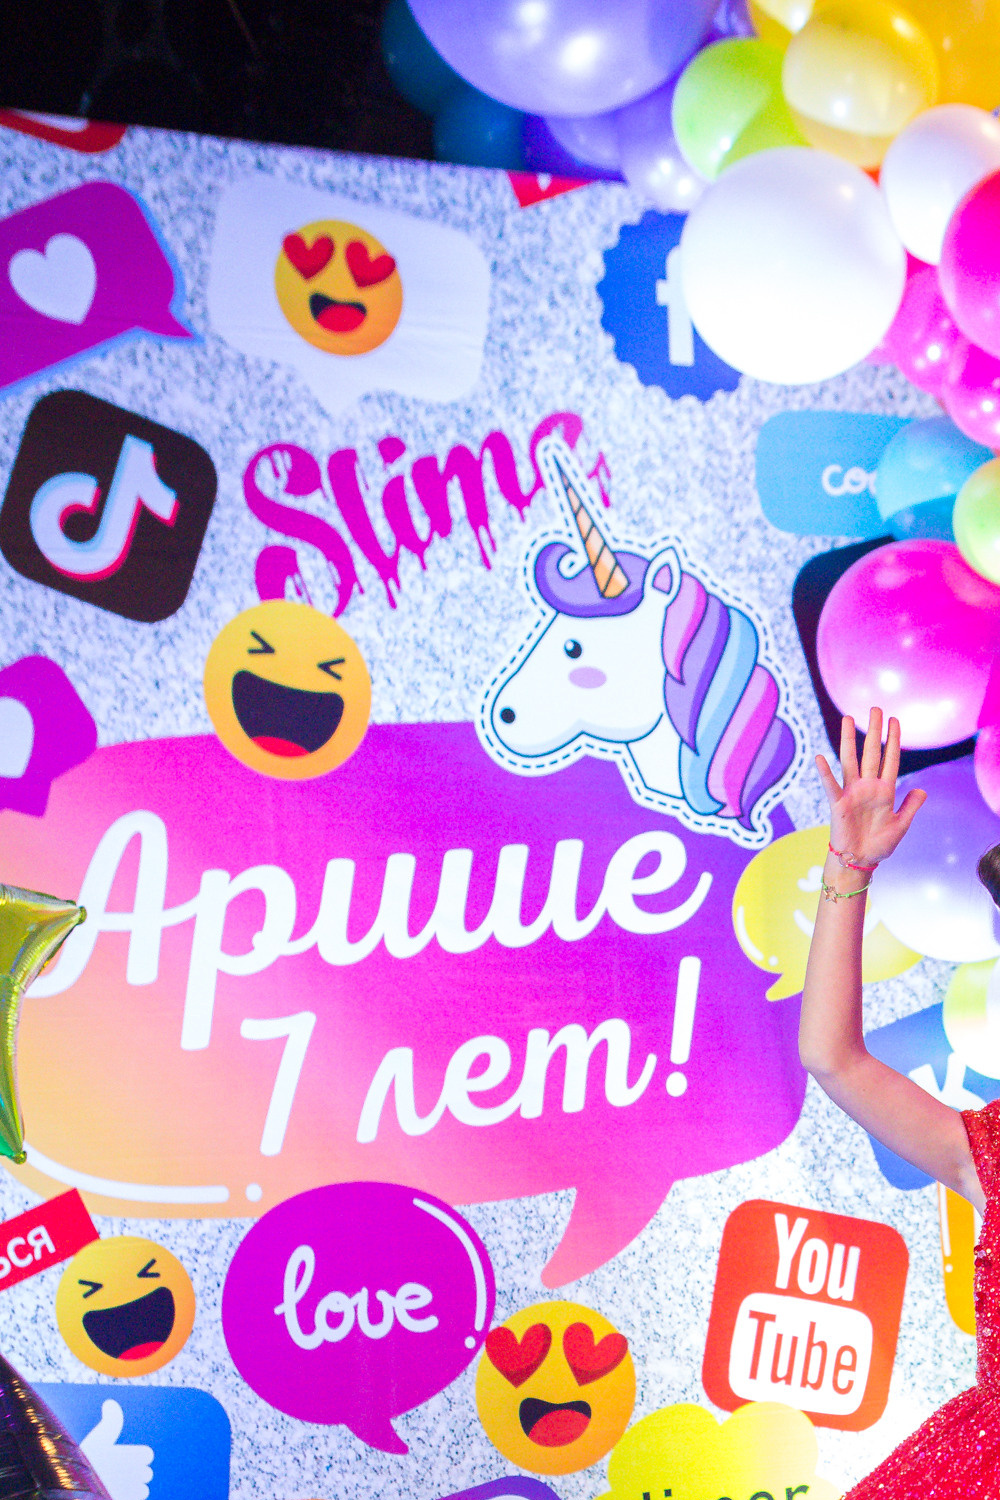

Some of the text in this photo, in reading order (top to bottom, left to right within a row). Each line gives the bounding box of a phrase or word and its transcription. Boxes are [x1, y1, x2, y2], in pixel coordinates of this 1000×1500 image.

[24, 810, 713, 1051] Арише
[240, 955, 702, 1156] 7 лет!
[274, 1244, 438, 1350] love
[773, 1213, 860, 1302] You
[746, 1310, 858, 1396] Tube
